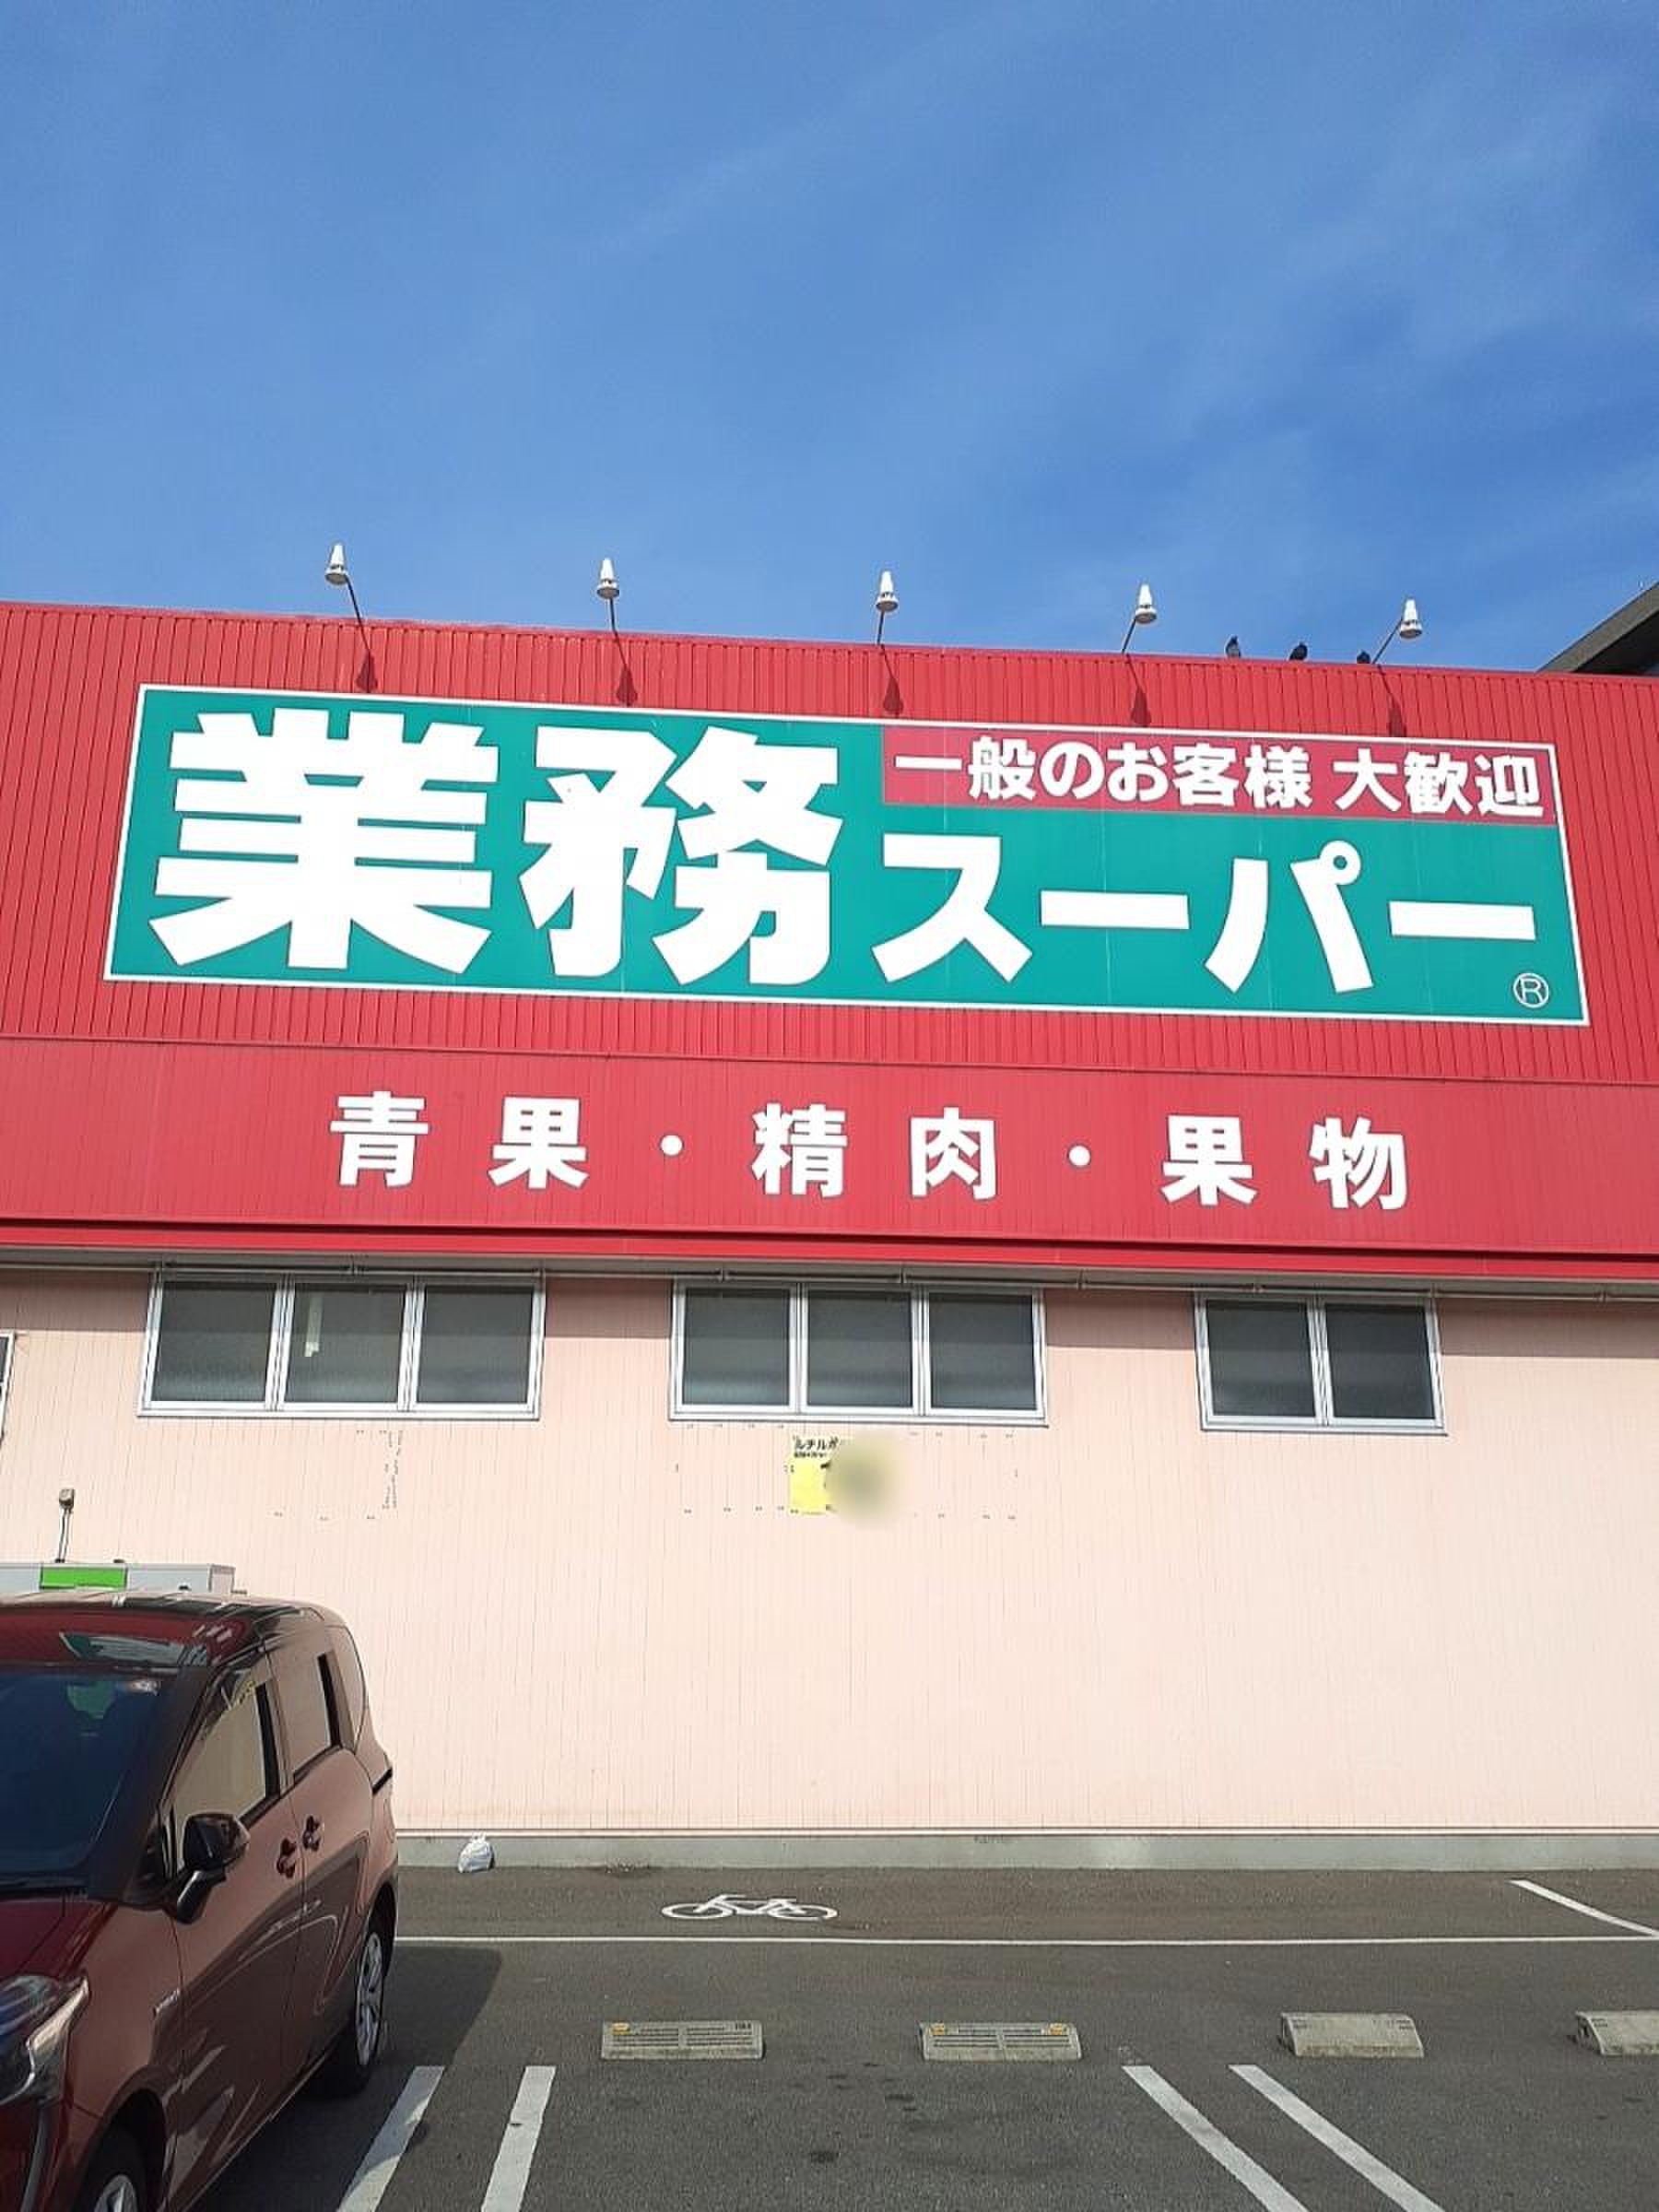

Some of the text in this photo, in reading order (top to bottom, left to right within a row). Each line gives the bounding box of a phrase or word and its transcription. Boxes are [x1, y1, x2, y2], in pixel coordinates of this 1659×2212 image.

[895, 735, 1545, 818] 一般のお客様 大歓迎
